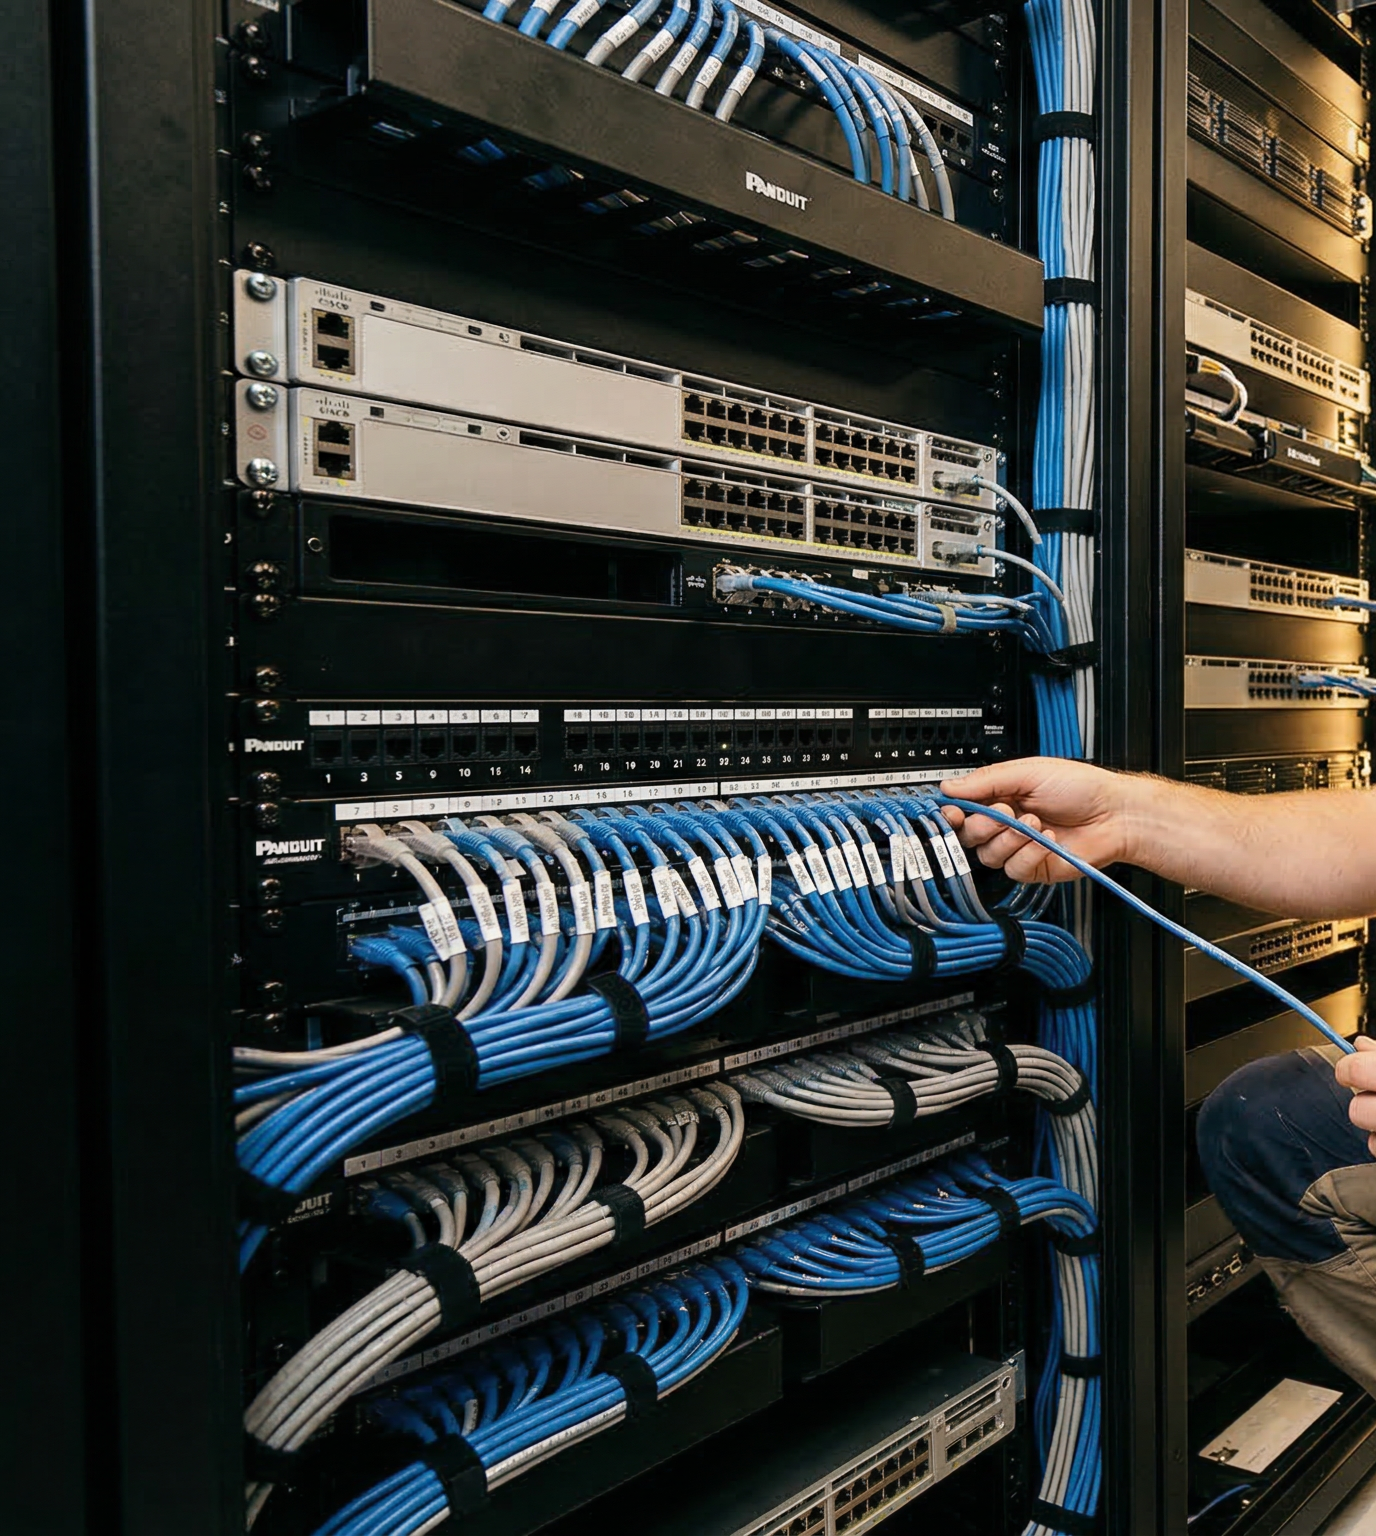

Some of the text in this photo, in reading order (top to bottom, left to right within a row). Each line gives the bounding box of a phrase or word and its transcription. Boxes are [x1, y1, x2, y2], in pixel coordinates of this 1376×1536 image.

[746, 170, 808, 211] PANDUIT
[244, 738, 305, 752] PANDUIT
[360, 771, 368, 783] 3
[458, 768, 472, 778] 10
[256, 839, 326, 856] PANDUIT
